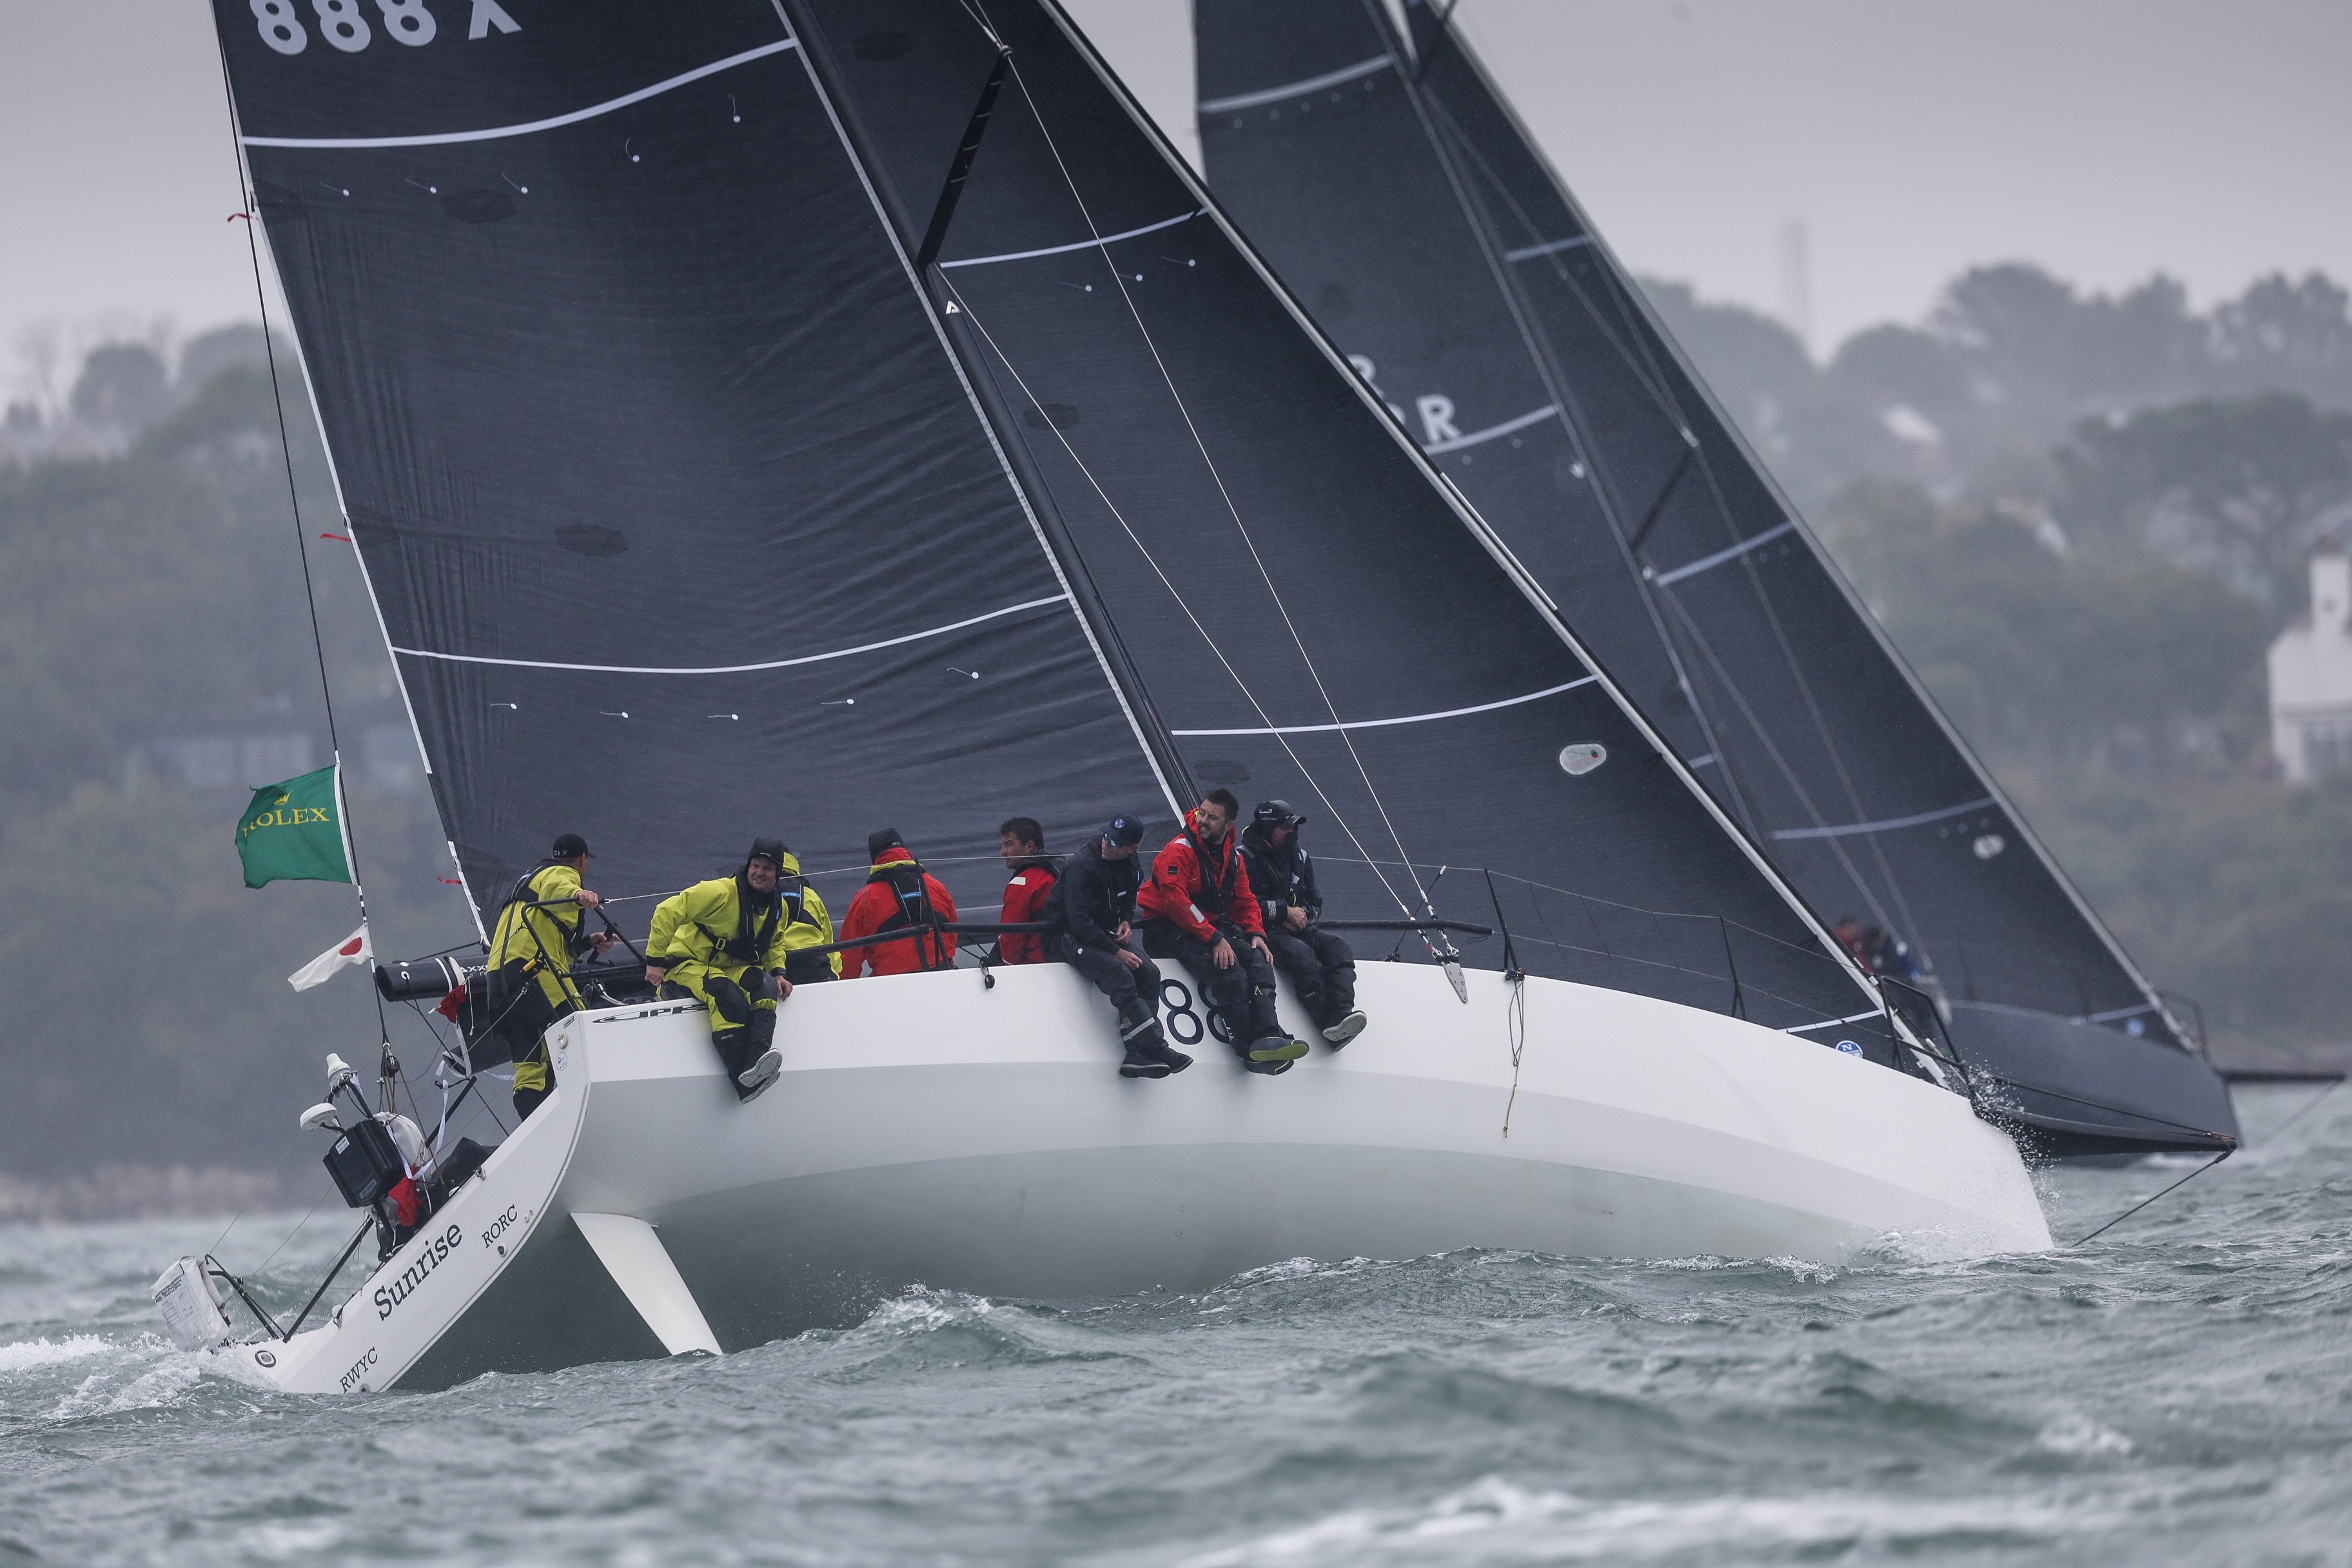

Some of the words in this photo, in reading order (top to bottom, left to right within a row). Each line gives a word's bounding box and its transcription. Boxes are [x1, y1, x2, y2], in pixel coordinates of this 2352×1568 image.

[481, 1204, 518, 1249] RORC
[374, 1224, 463, 1321] Sunrise
[339, 1346, 378, 1393] RWYC
